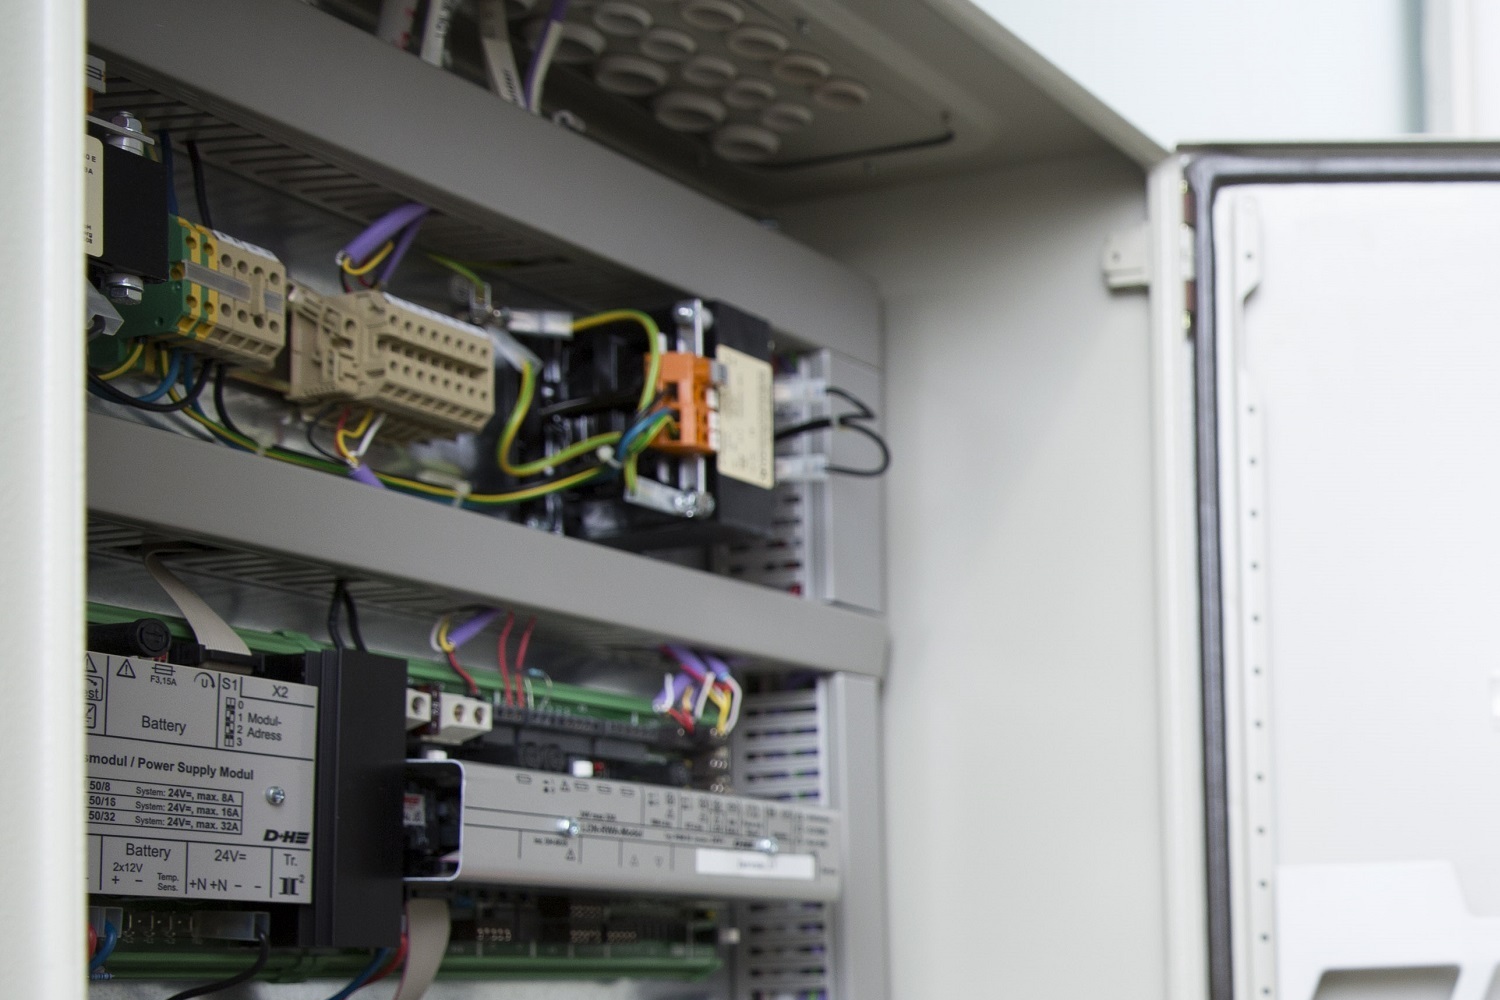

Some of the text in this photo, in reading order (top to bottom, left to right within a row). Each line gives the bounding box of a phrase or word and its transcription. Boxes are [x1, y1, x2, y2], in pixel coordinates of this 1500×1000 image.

[221, 677, 238, 691] S1
[271, 684, 289, 699] X2
[238, 700, 244, 710] 0
[238, 713, 243, 722] 1
[247, 712, 283, 727] Modul-
[141, 714, 187, 736] Battery
[237, 725, 243, 734] 2
[246, 726, 283, 742] Adress
[236, 737, 243, 747] 3
[137, 757, 175, 772] Power
[177, 761, 217, 779] Supply
[219, 765, 254, 780] Modul
[89, 781, 111, 792] 50/8
[135, 786, 166, 798] System:
[196, 792, 220, 802] max.
[221, 793, 235, 803] 8A
[88, 795, 116, 807] 50/16
[135, 801, 166, 813] System:
[196, 806, 219, 816] max.
[221, 807, 240, 818] 16A
[88, 810, 116, 822] 50/32
[134, 815, 165, 827] System:
[196, 821, 219, 830] max.
[220, 821, 239, 832] 32A
[125, 842, 172, 861] Battery
[214, 849, 247, 862] 24V=
[283, 853, 298, 867] Tr.
[112, 862, 144, 873] 2x12V
[157, 872, 179, 883] Temp.
[189, 877, 228, 892] +N +N
[157, 882, 179, 892] Sens.
